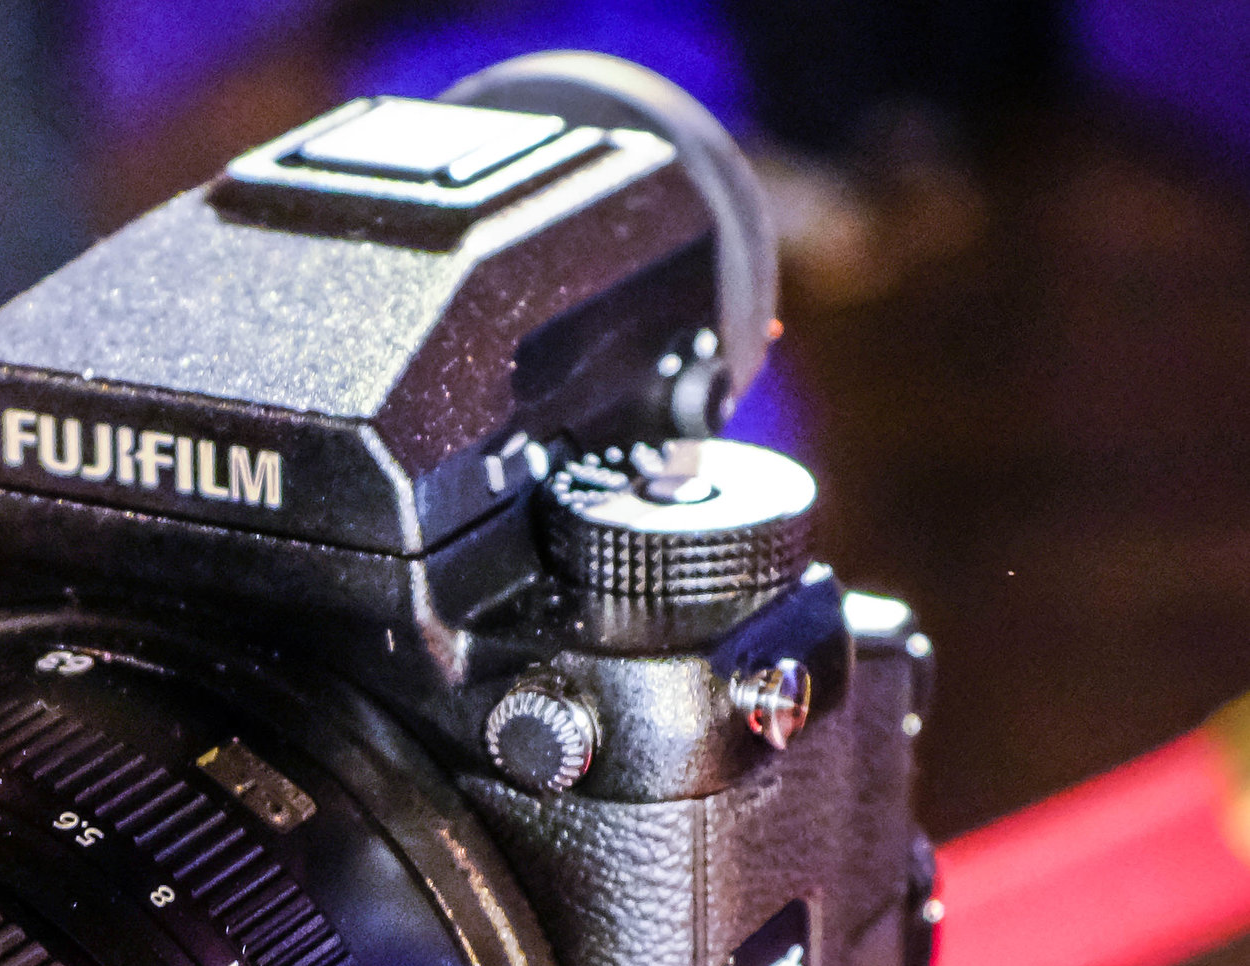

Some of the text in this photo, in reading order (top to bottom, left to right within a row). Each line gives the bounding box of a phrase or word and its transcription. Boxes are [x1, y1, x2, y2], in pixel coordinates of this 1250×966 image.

[3, 407, 283, 509] FUJIFILM
[53, 811, 104, 848] 5.6
[150, 884, 176, 908] 8
